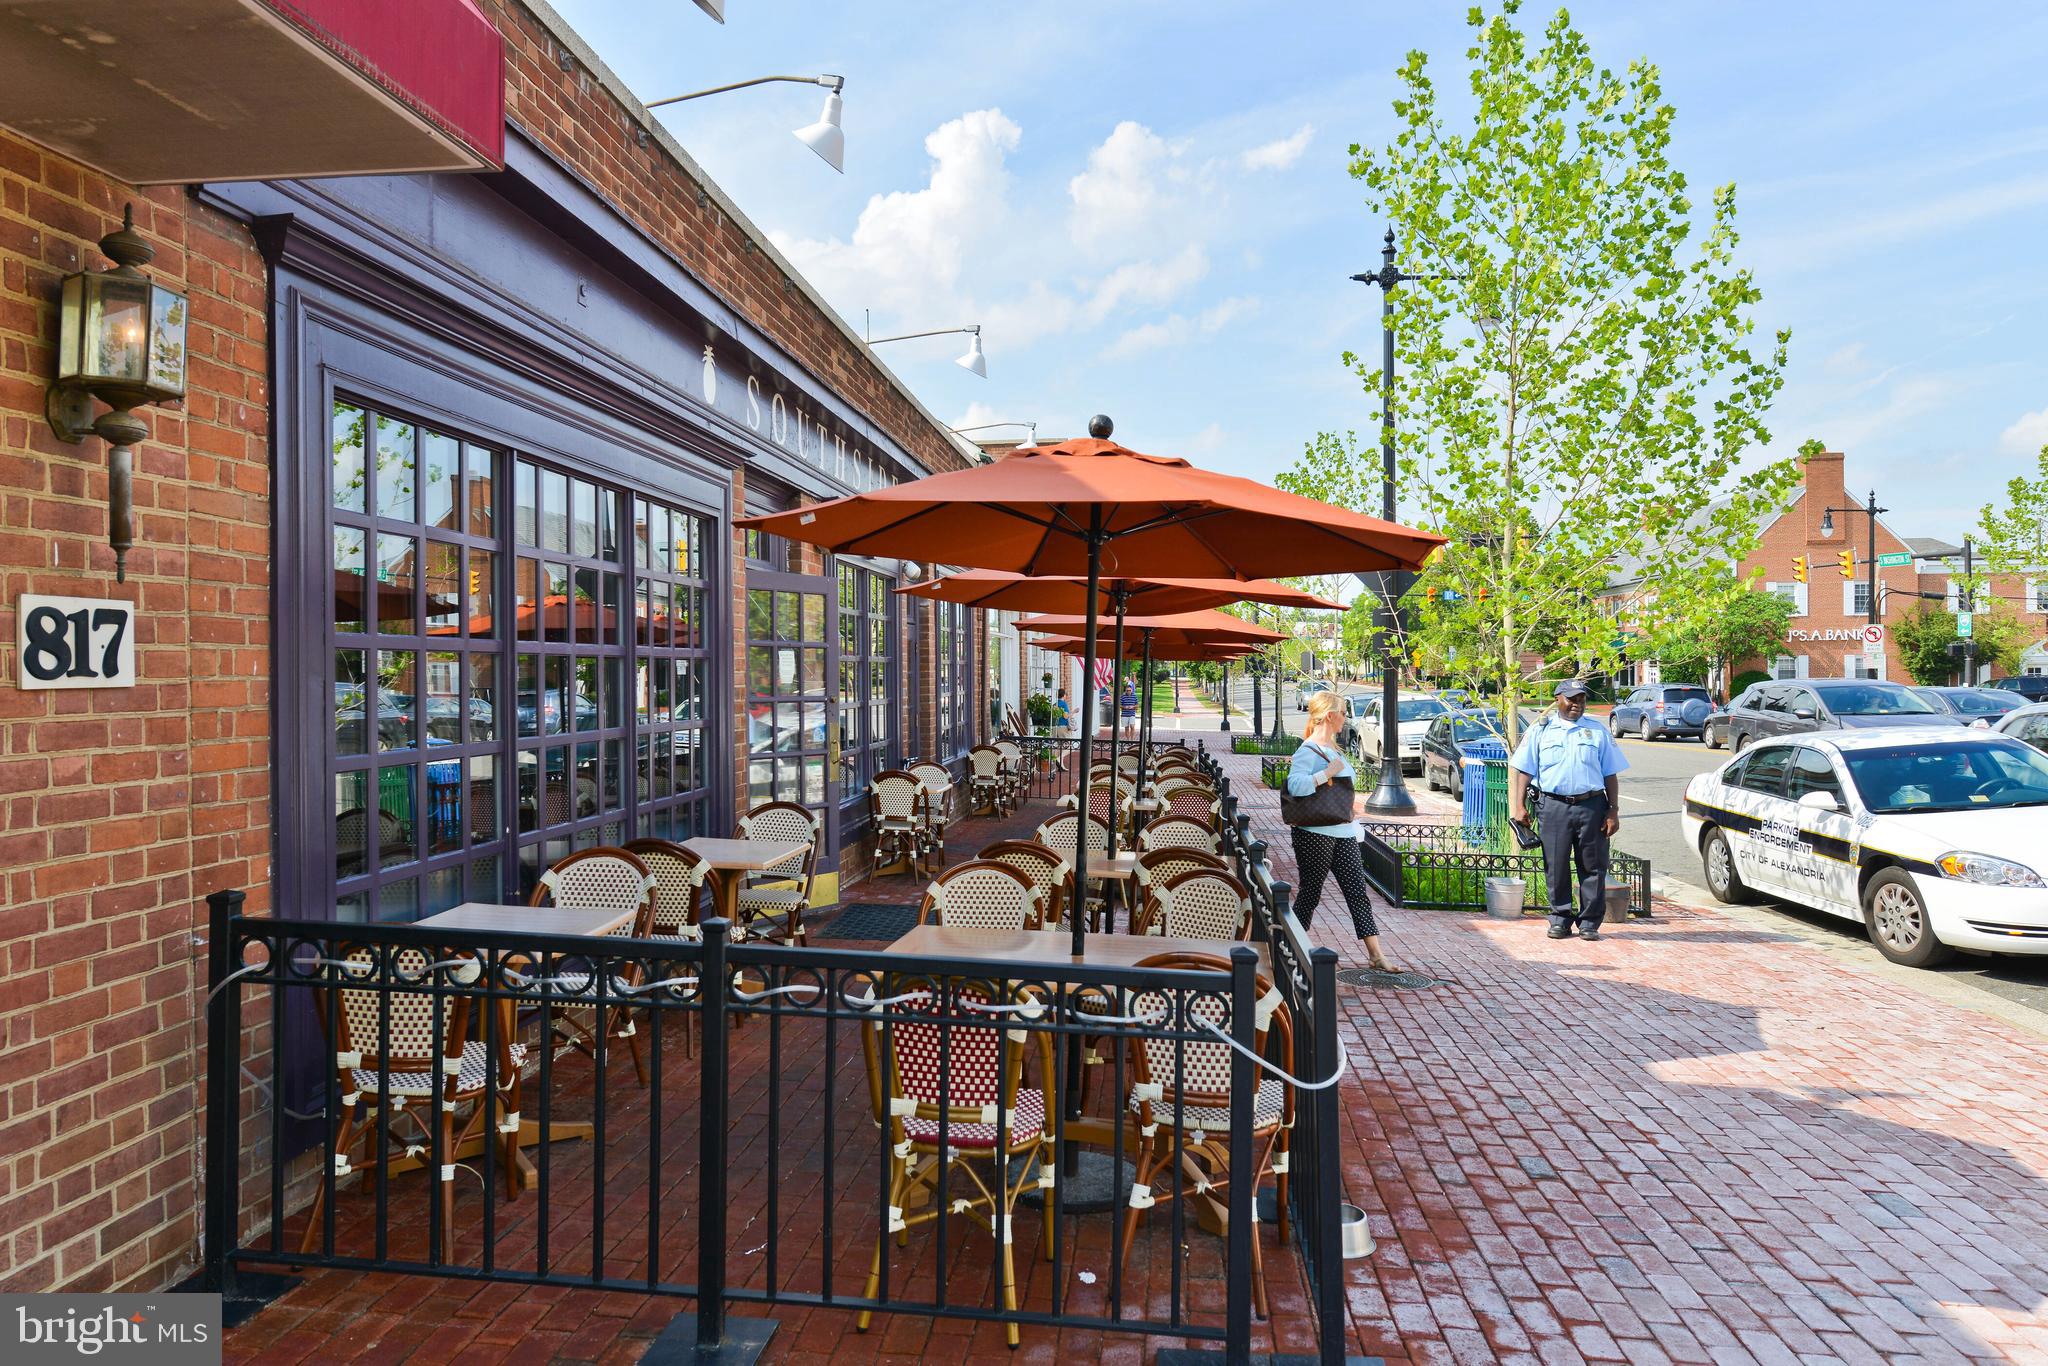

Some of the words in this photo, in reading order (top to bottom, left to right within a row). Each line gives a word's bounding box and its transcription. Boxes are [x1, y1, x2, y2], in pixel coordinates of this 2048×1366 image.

[24, 606, 128, 680] 817
[1749, 829, 1812, 855] ENFORCEMENT
[1761, 819, 1799, 837] PARKING
[1740, 849, 1757, 860] CITY
[1758, 854, 1769, 865] OF
[1771, 860, 1826, 882] ALEXANDRIA
